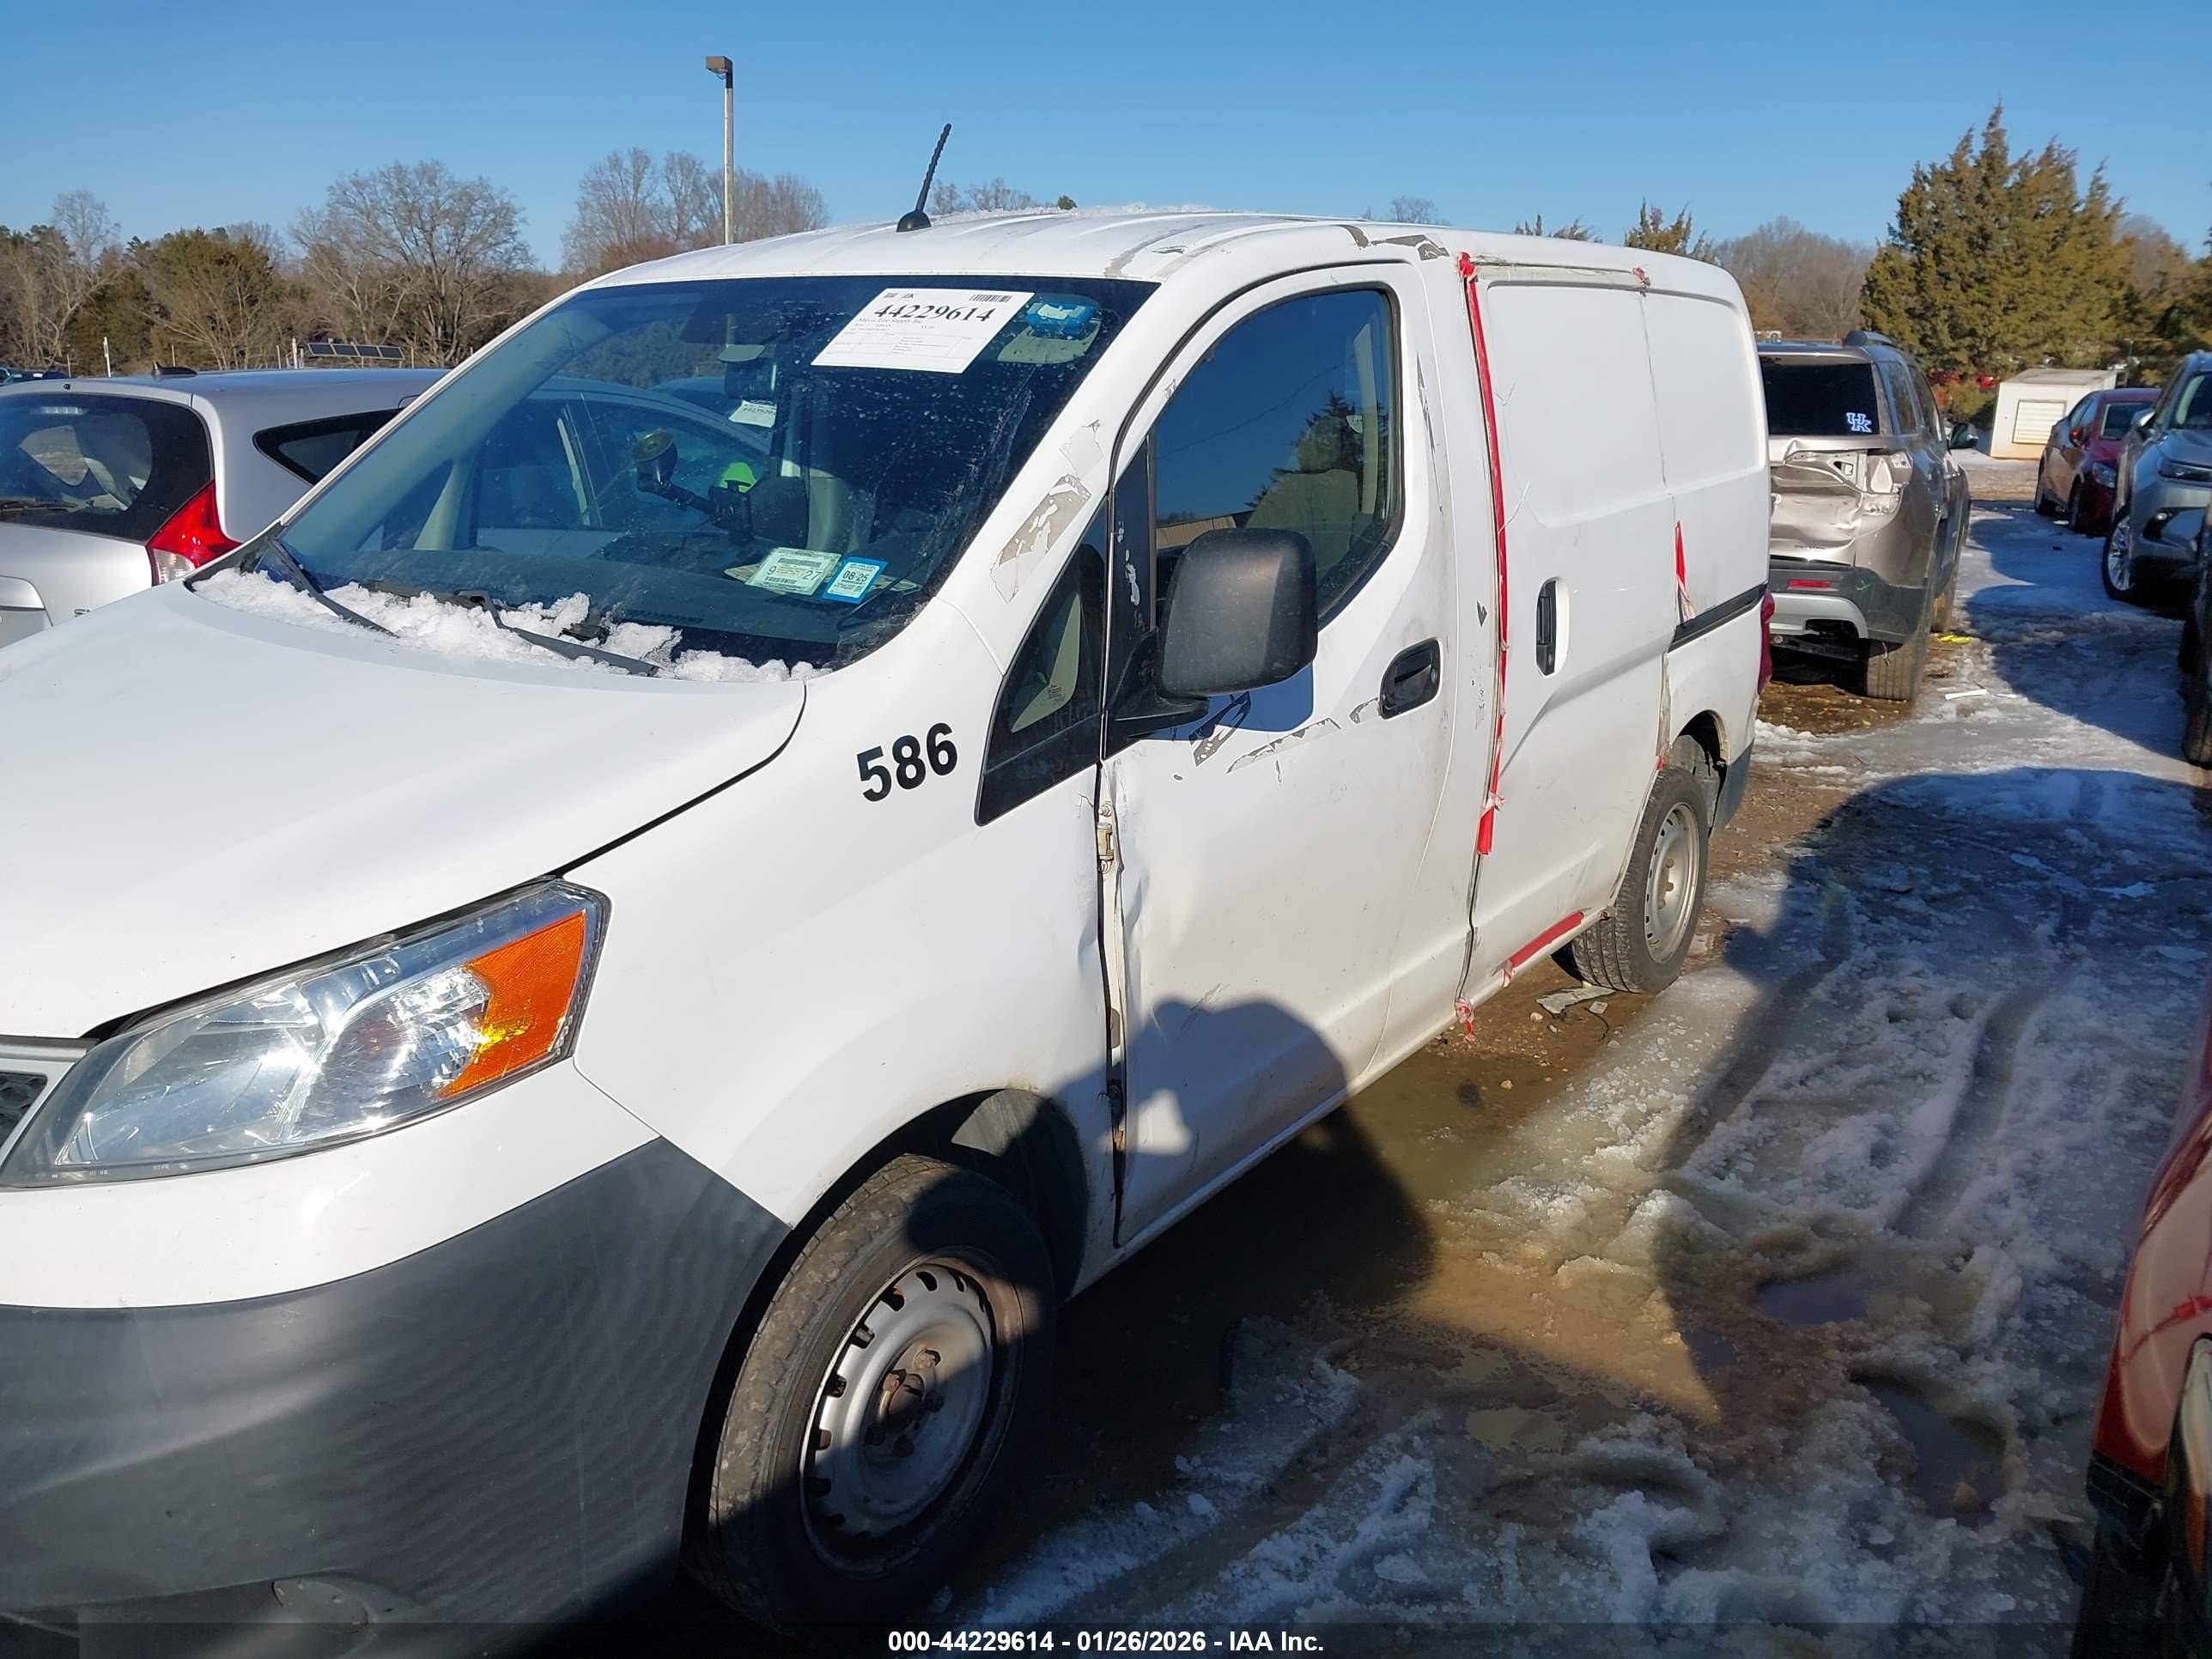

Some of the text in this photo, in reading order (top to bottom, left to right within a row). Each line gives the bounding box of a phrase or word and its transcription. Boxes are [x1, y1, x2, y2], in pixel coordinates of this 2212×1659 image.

[874, 304, 997, 322] 44229614
[1846, 412, 1872, 433] UK
[767, 565, 776, 575] 9
[802, 569, 823, 581] 27
[857, 723, 957, 801] 586
